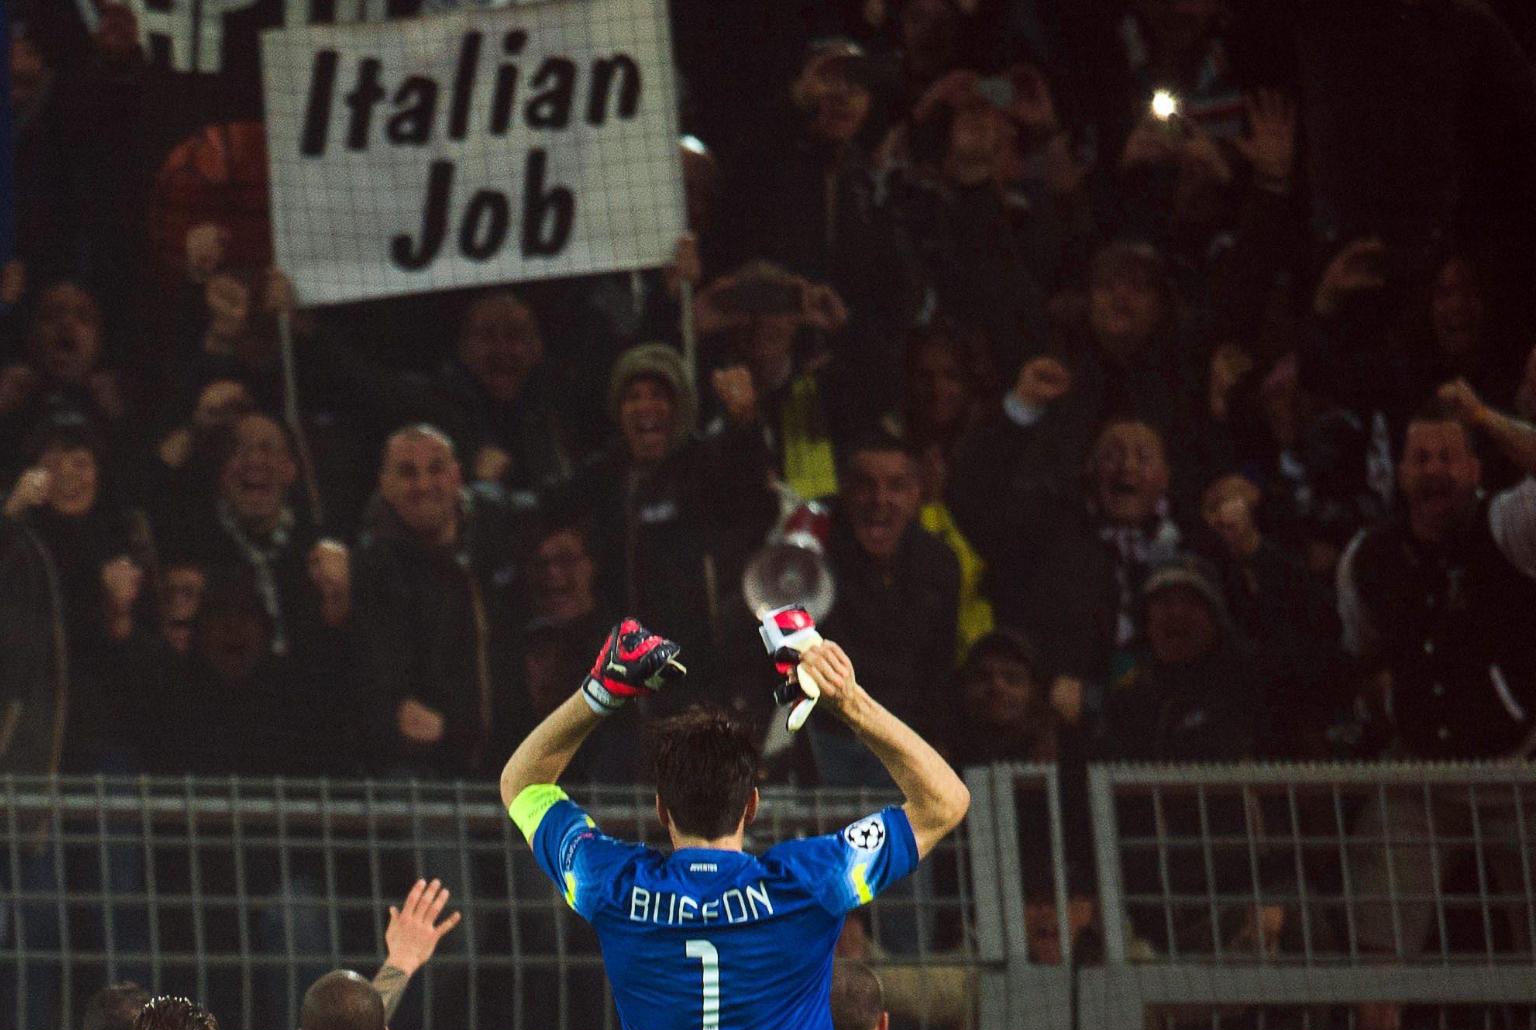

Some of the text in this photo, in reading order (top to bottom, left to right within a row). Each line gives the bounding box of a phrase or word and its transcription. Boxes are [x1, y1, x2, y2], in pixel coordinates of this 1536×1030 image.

[301, 28, 641, 158] Italian
[390, 147, 576, 273] Job
[629, 880, 774, 926] BUFFON
